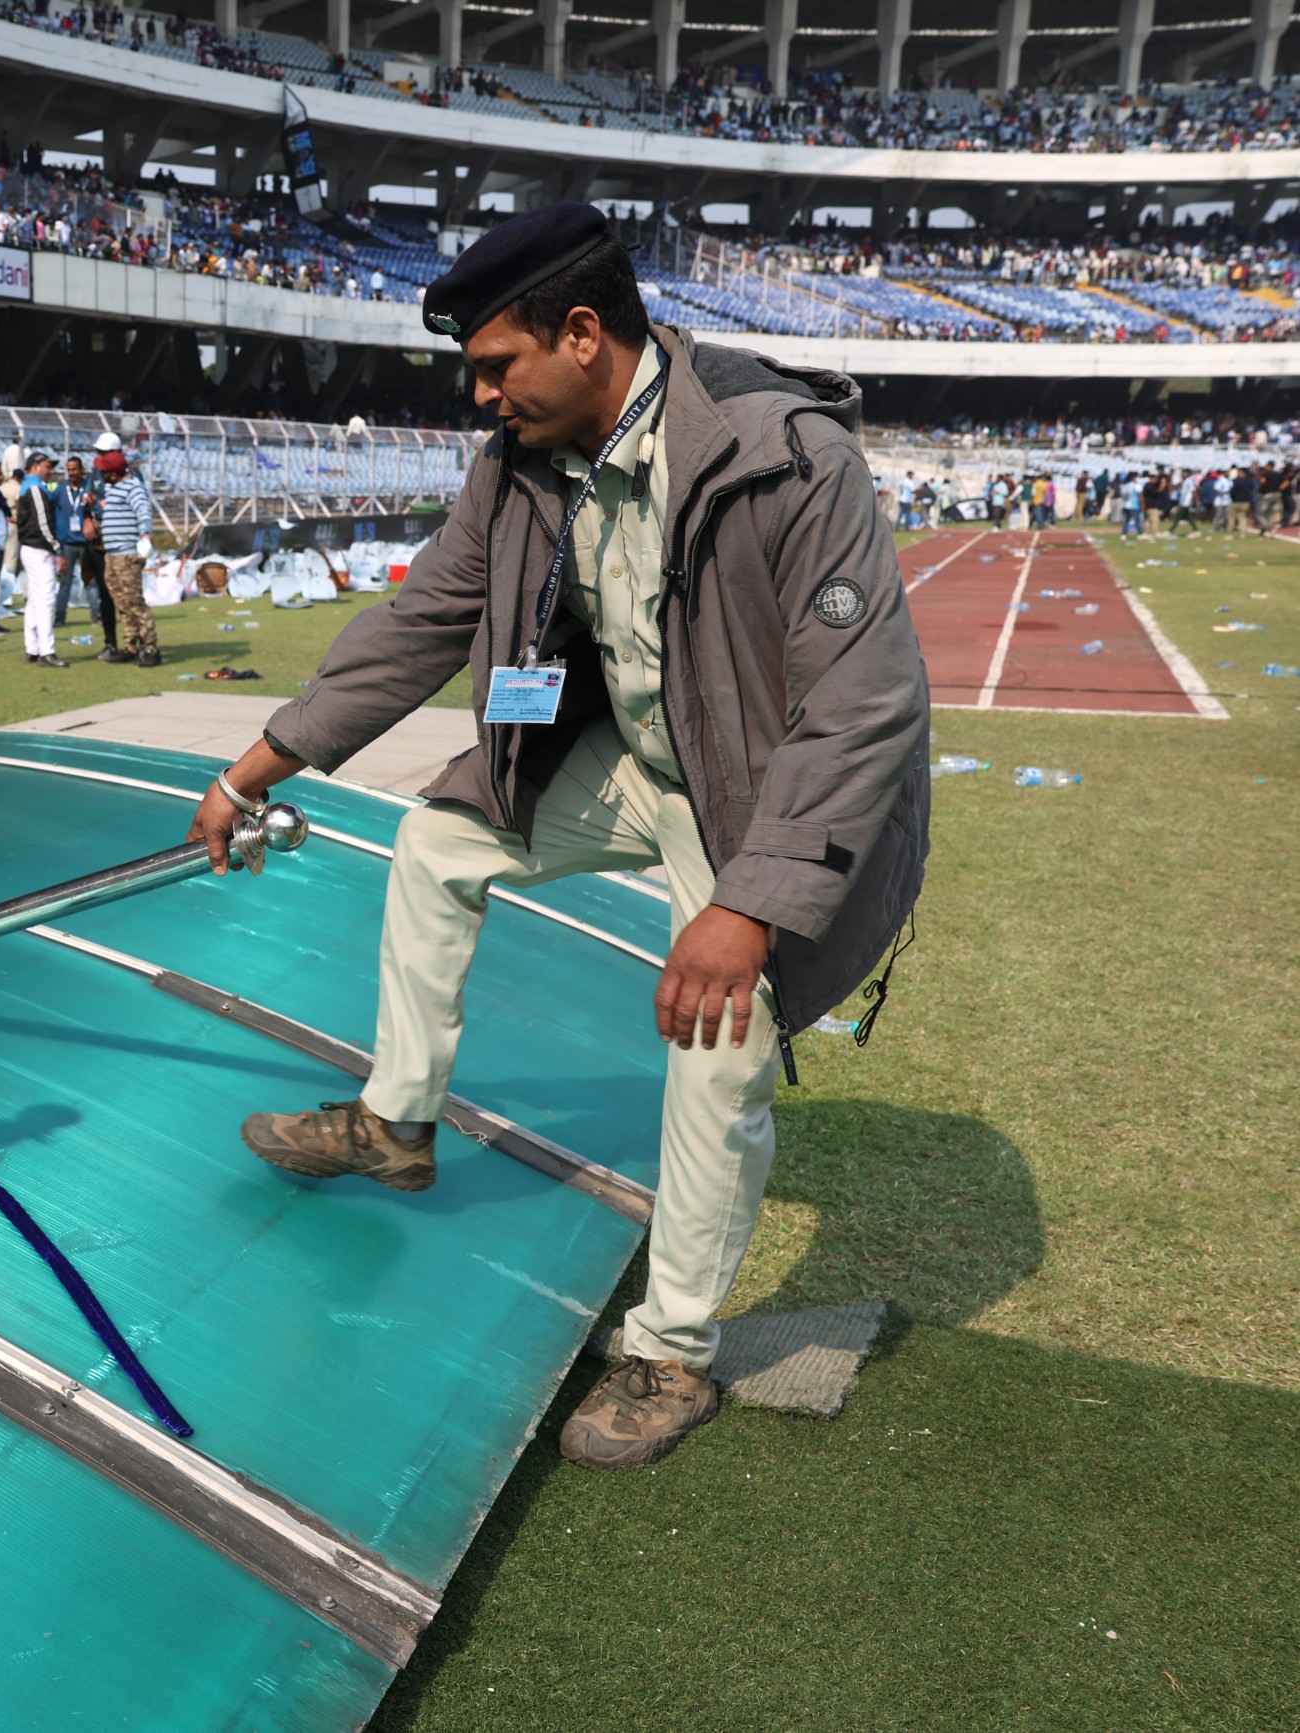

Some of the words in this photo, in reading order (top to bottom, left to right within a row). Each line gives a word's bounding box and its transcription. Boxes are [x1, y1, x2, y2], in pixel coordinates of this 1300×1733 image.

[594, 428, 624, 470] HOWRAH
[622, 404, 641, 427] CITY
[574, 479, 593, 512] POLICE
[541, 576, 557, 619] HOWRAH
